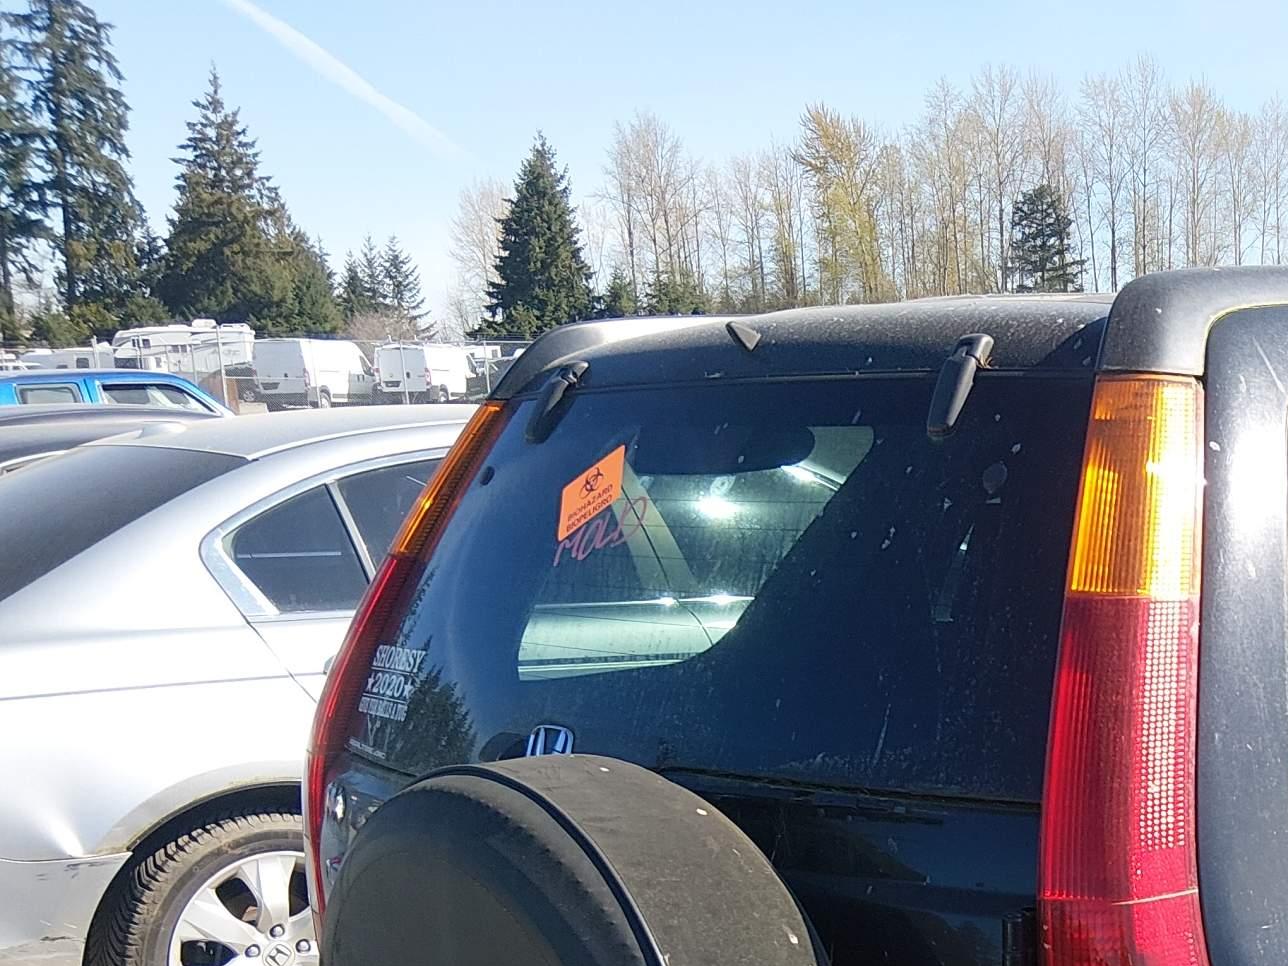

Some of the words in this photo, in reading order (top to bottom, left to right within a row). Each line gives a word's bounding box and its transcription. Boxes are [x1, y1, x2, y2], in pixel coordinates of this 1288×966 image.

[566, 495, 613, 532] BIOPELIGRO
[567, 484, 613, 520] BIOHAZARD
[372, 645, 426, 673] SHORESY
[372, 673, 404, 698] 2020
